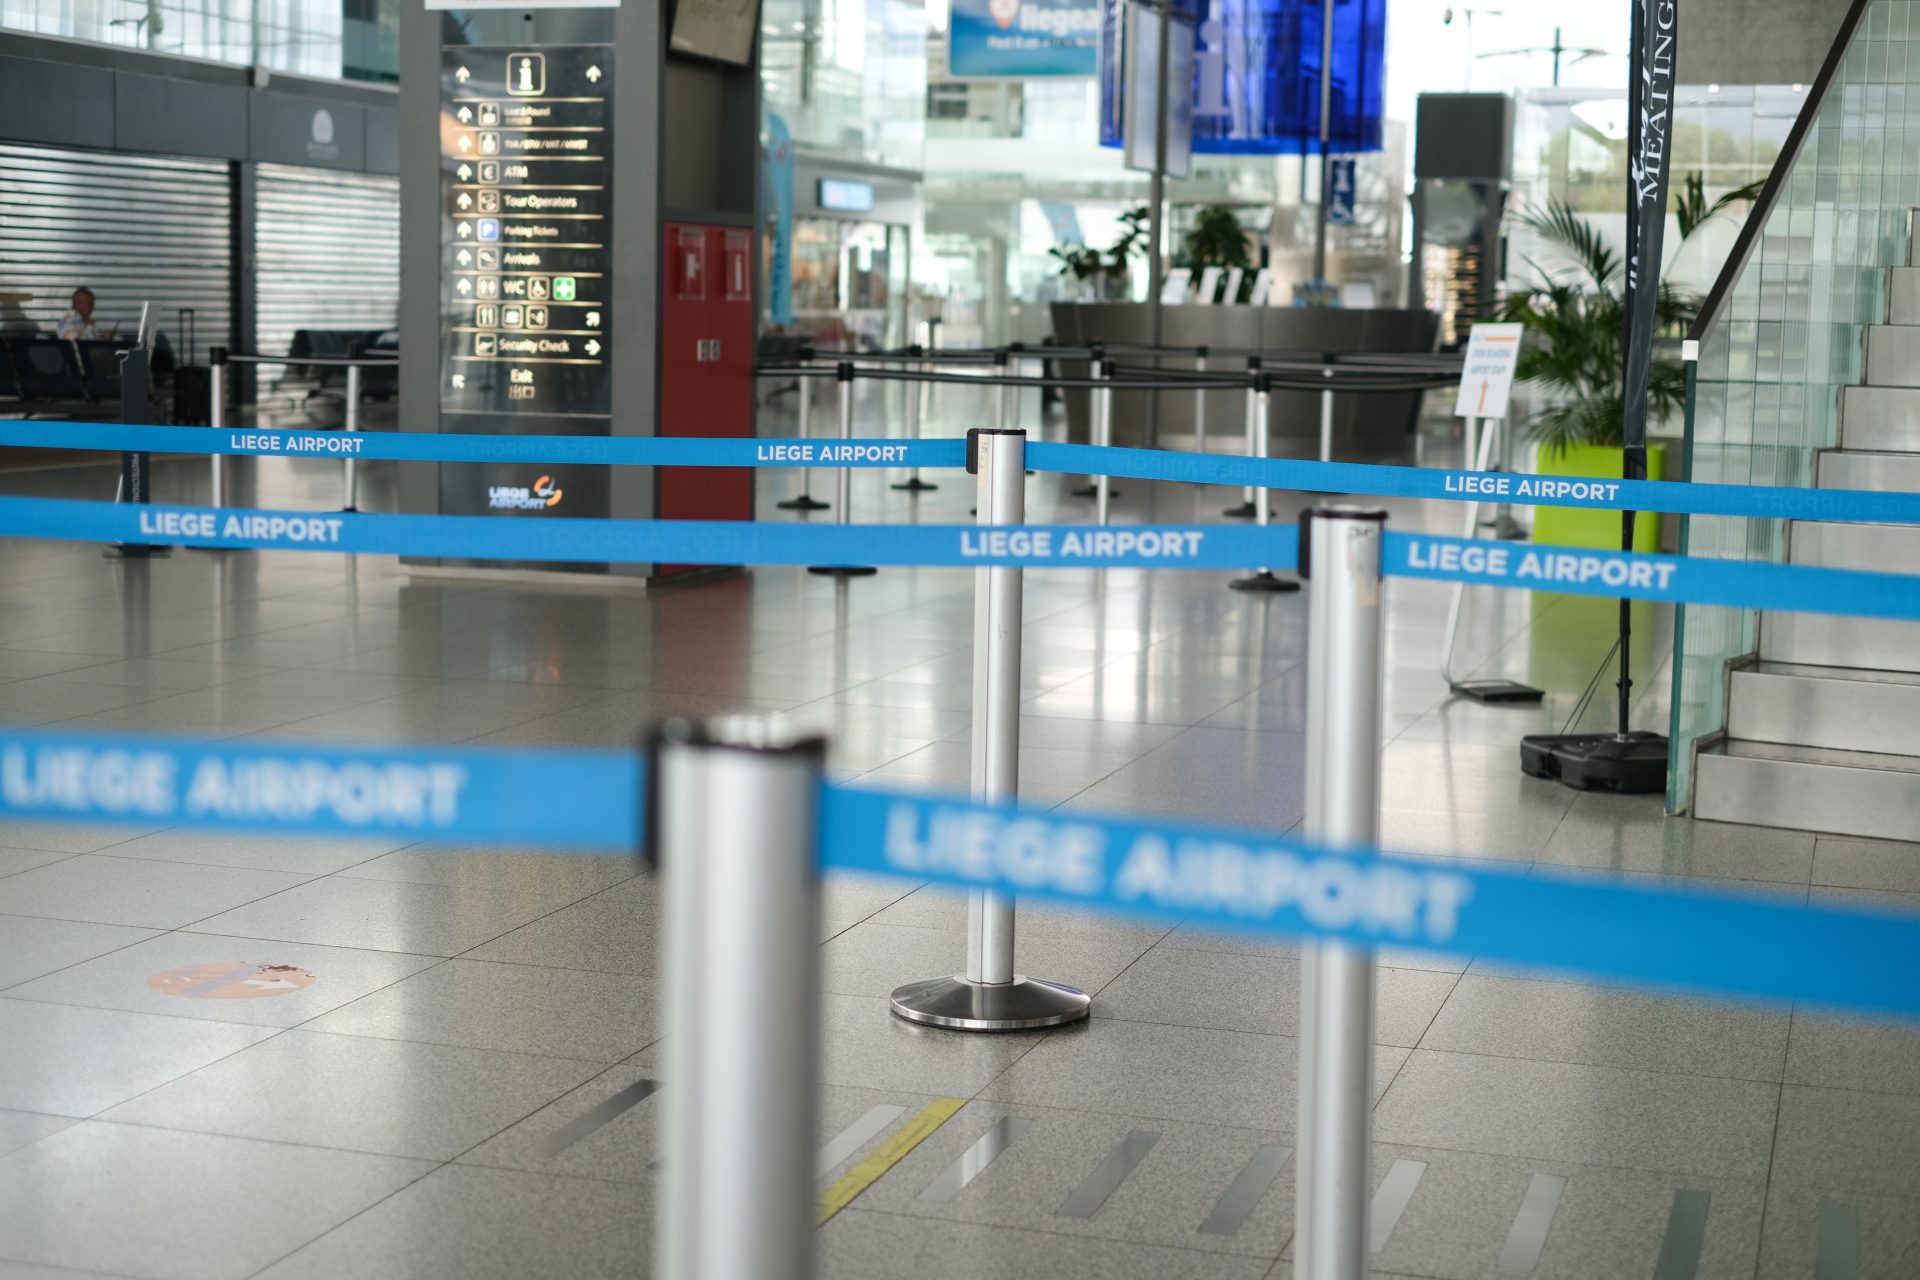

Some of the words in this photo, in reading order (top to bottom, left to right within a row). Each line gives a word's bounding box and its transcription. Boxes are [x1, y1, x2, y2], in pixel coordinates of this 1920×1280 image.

[1641, 1, 1675, 202] MEATING
[504, 166, 529, 178] ATM
[504, 194, 527, 208] Tour
[527, 194, 578, 210] Operators
[504, 252, 541, 266] Arrivals
[503, 280, 526, 295] WC
[499, 338, 537, 354] Security
[539, 339, 570, 352] Check
[510, 368, 534, 383] Exit
[231, 434, 281, 450] LIEGE
[285, 436, 364, 453] AIRPORT
[757, 445, 813, 461] LIEGE
[819, 445, 907, 462] AIRPORT
[489, 487, 530, 498] LIEGE
[1445, 475, 1510, 495] LIEGE
[1516, 479, 1620, 501] AIRPORT
[489, 497, 546, 510] AIRPORT
[140, 511, 217, 537] LIEGE
[223, 515, 343, 543] AIRPORT
[960, 530, 1052, 557] LIEGE
[1060, 530, 1204, 558] AIRPORT
[1408, 541, 1509, 576] LIEGE
[1516, 551, 1676, 590] AIRPORT
[1, 746, 177, 815] LIEGE
[184, 755, 468, 828] AIRPORT
[884, 800, 1107, 898] LIEGE
[1111, 831, 1472, 942] AIRPORT
